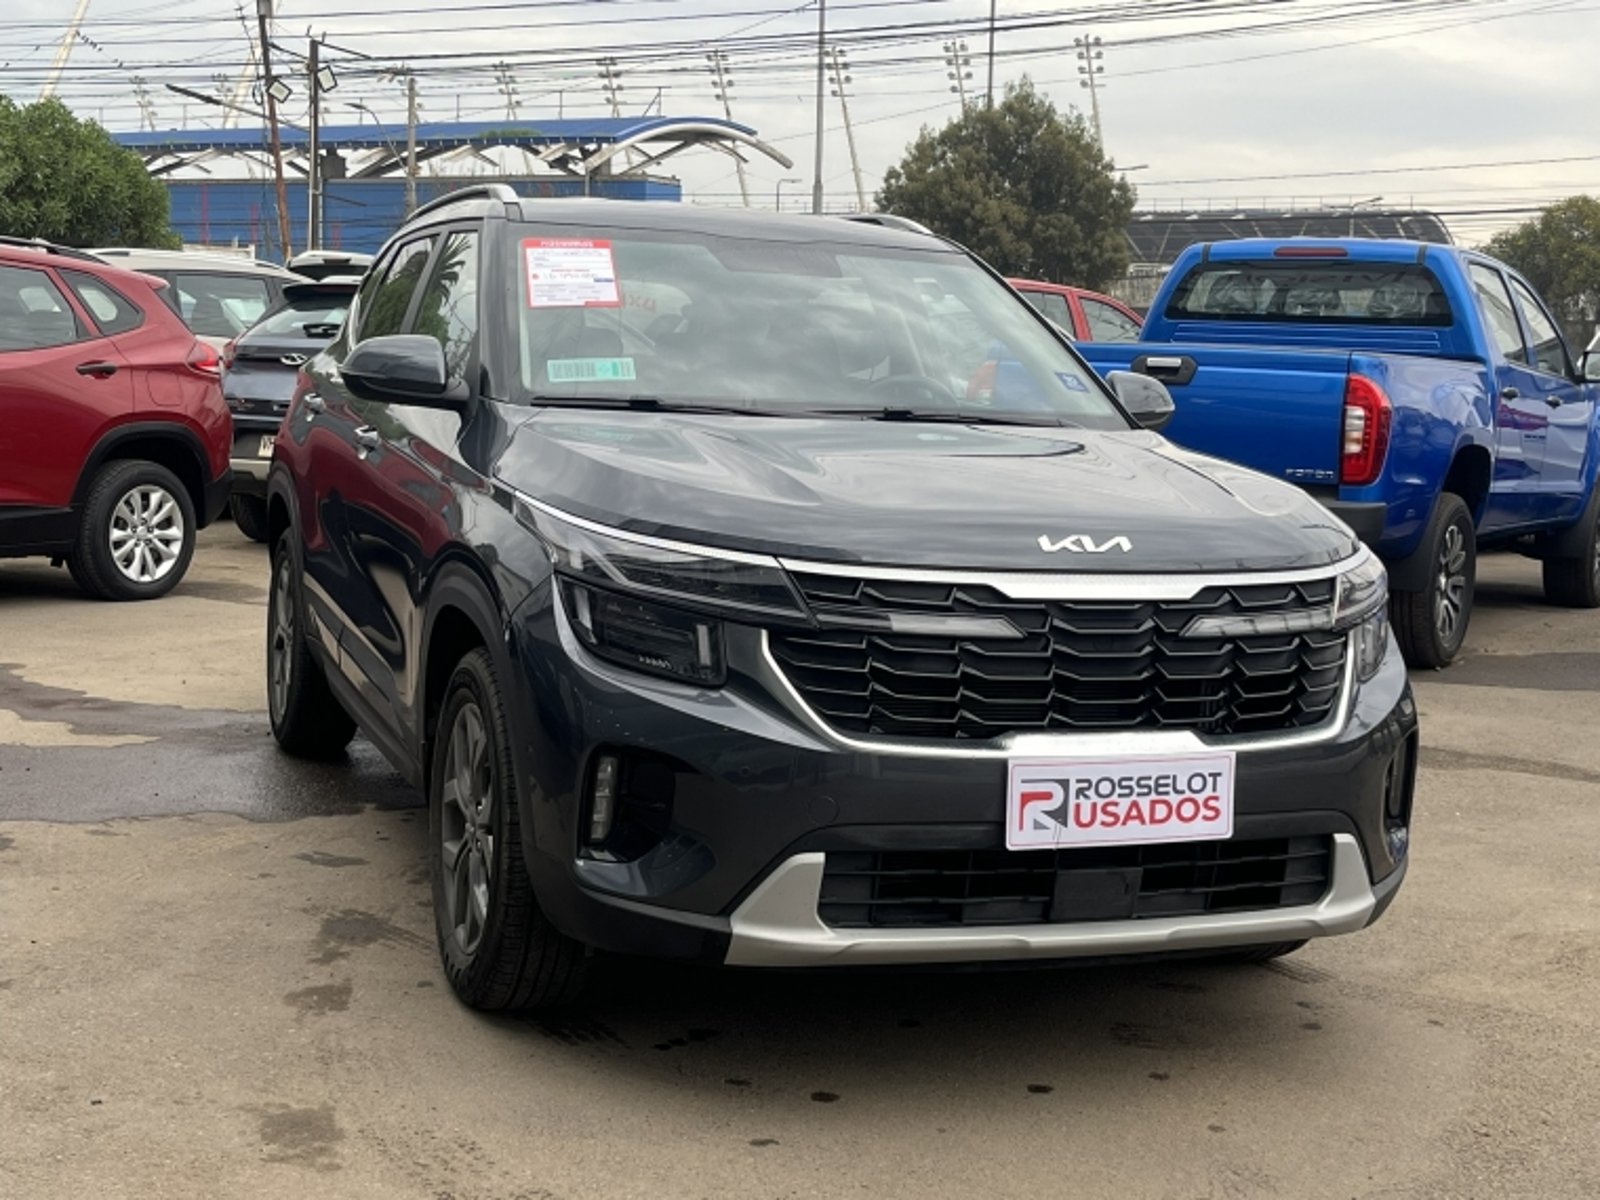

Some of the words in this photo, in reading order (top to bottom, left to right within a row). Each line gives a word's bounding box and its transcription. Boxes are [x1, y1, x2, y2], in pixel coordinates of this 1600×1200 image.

[1037, 533, 1133, 552] KIA
[1075, 772, 1222, 800] ROSSELOT
[1073, 796, 1221, 828] USADOS
